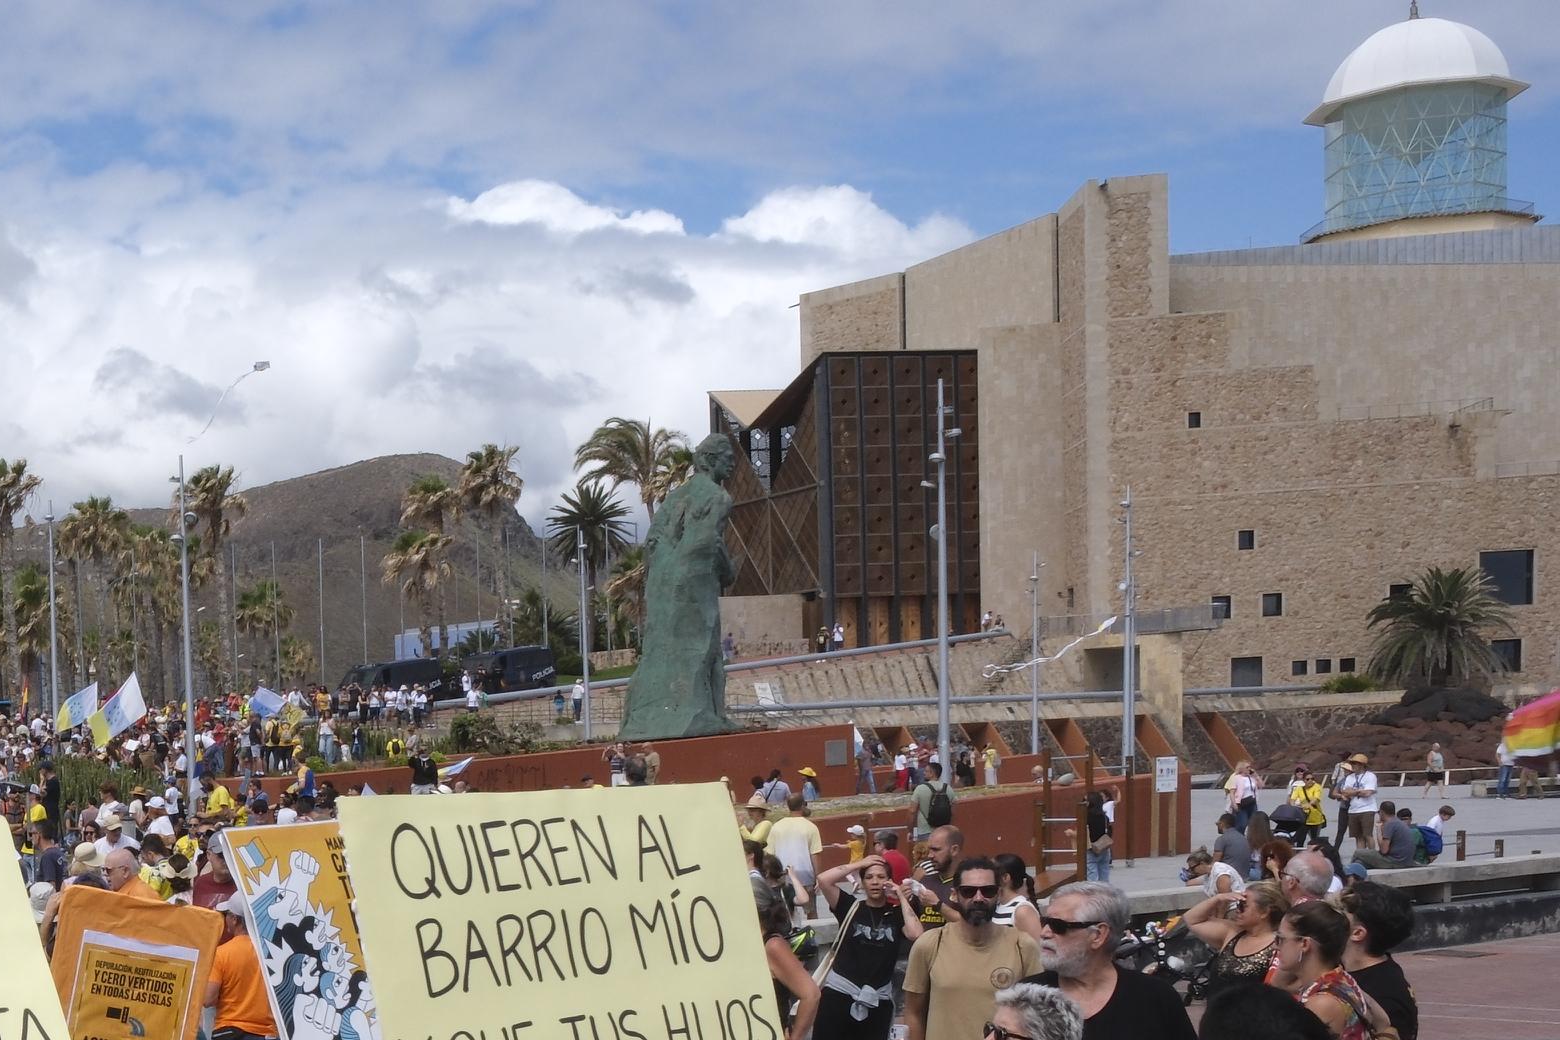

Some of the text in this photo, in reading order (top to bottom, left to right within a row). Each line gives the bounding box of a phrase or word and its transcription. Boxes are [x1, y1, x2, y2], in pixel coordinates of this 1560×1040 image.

[390, 814, 701, 899] QUIEREN AL
[415, 888, 725, 999] BARRIO MÍO
[95, 960, 133, 975] DEPURACIÓN,
[91, 983, 172, 1007] EN TODAS LAS ISLAS
[94, 969, 174, 995] Y CERO VERTIDOS
